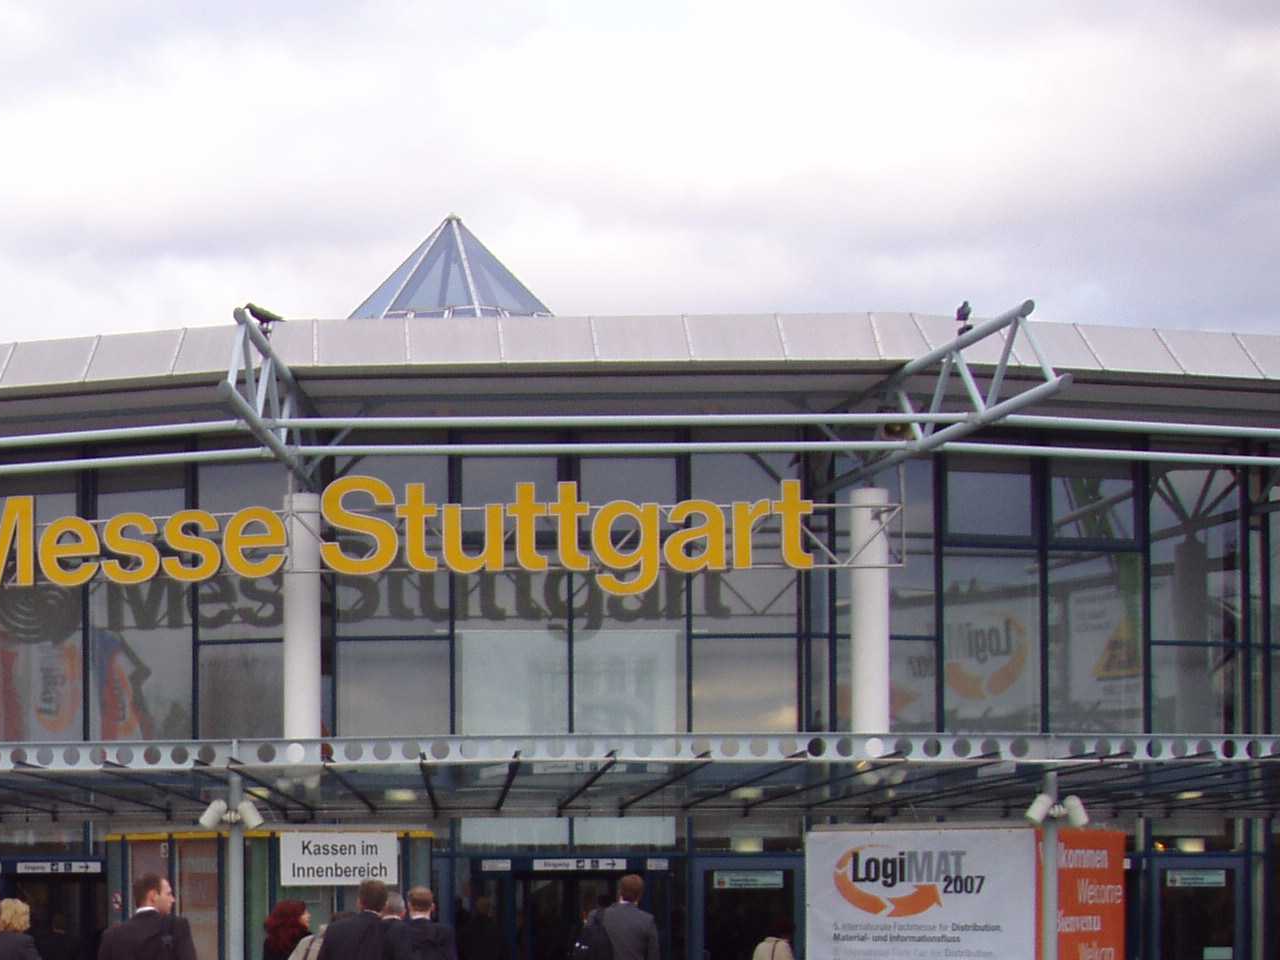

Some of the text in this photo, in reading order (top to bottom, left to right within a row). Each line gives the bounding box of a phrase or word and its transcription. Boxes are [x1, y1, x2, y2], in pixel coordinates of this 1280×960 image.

[320, 475, 815, 597] Stuttgart
[301, 840, 379, 856] Kassen im
[292, 862, 388, 878] Innenbereich
[852, 851, 967, 888] LogiMAT
[943, 875, 986, 895] 2007
